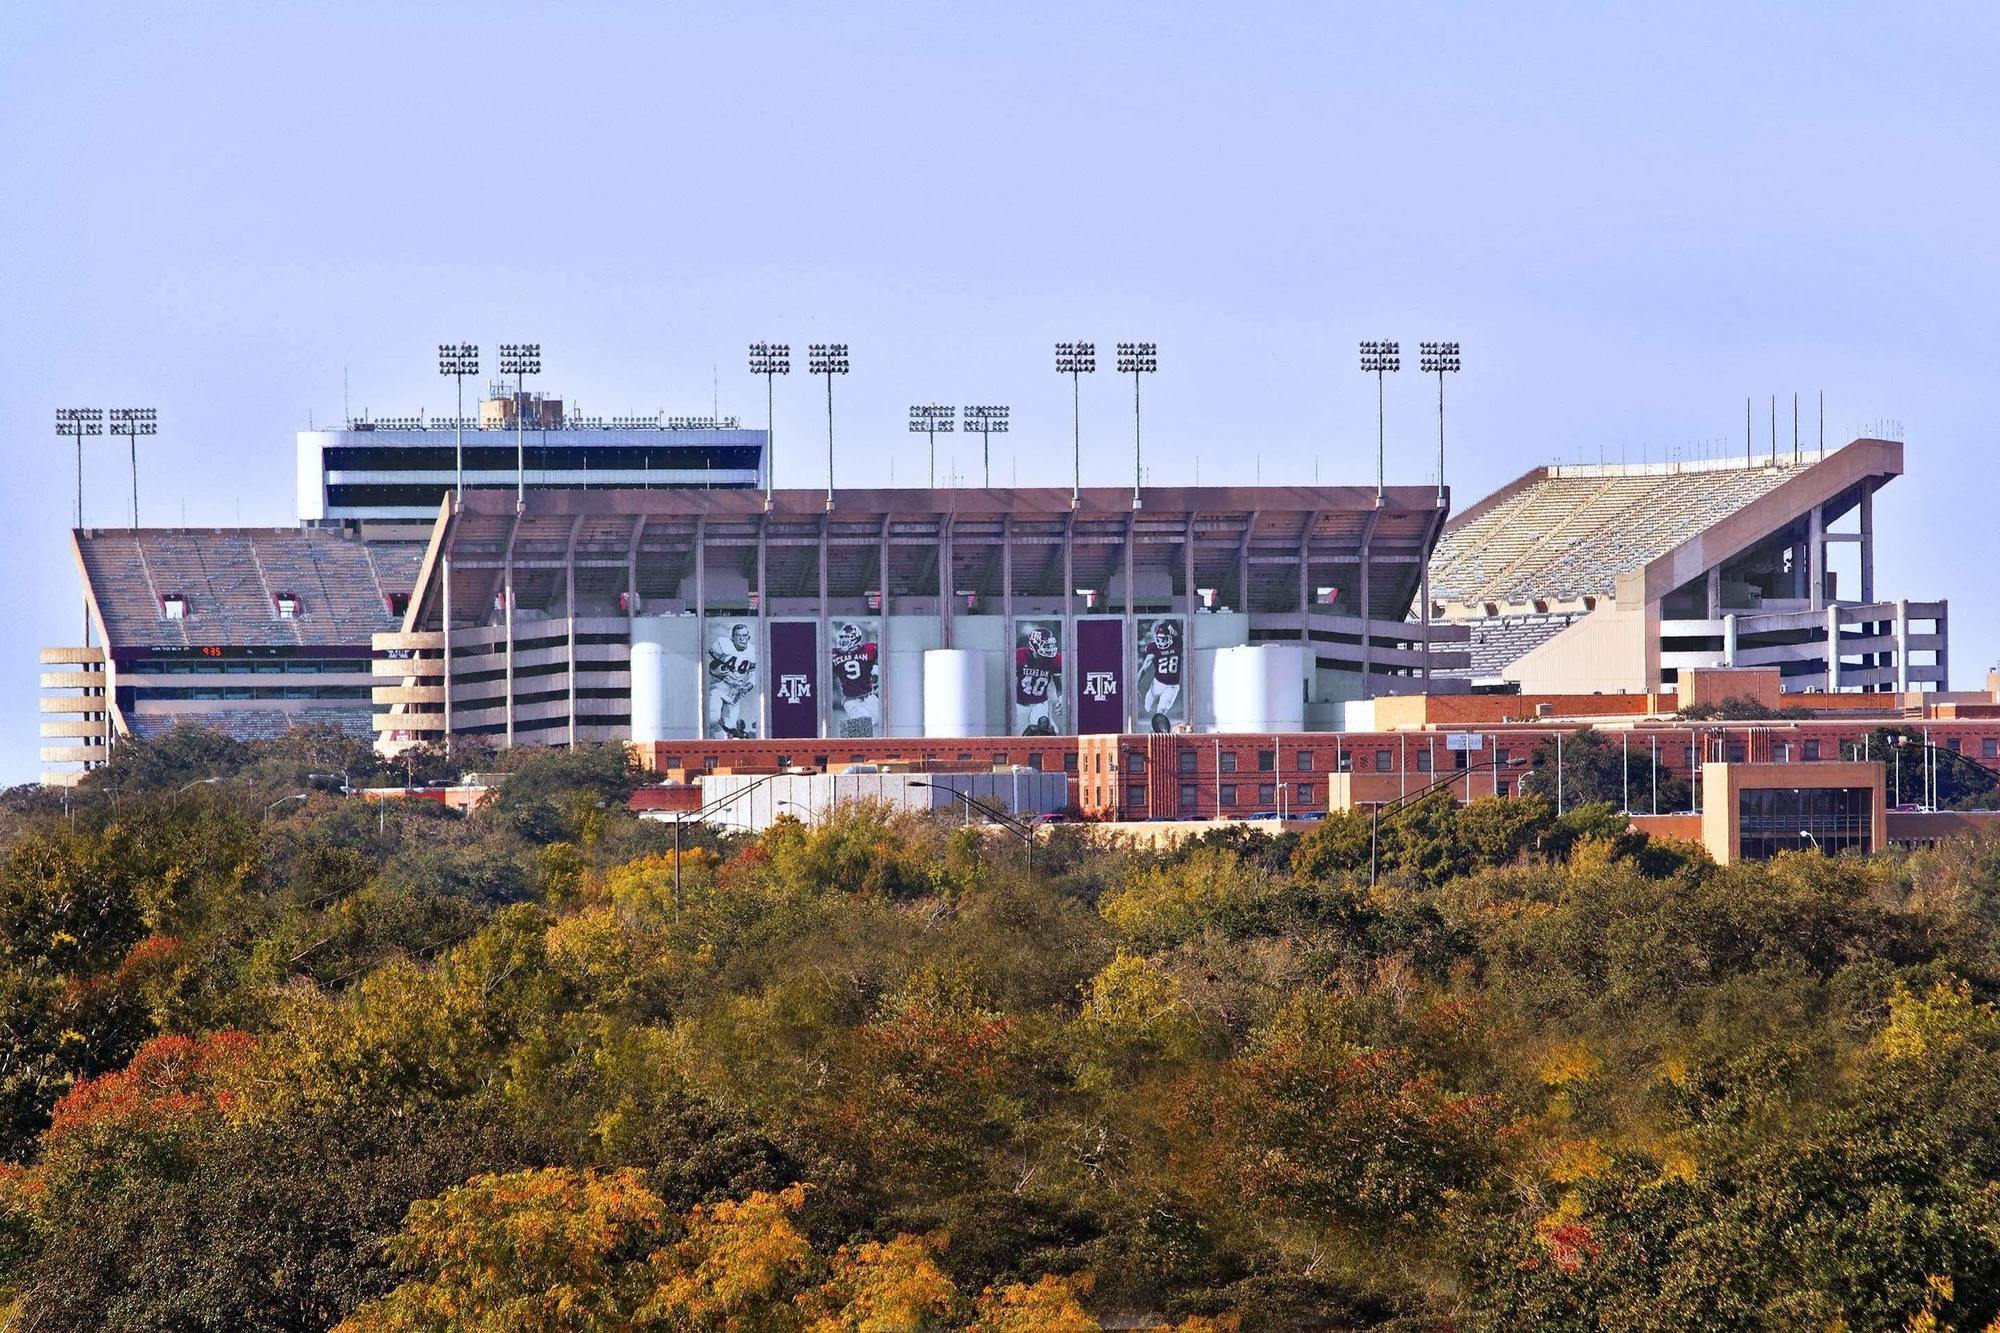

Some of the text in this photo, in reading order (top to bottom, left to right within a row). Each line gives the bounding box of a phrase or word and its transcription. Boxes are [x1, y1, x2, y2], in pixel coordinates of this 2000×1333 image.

[832, 654, 852, 666] TEXAS
[1158, 655, 1179, 674] 28
[844, 660, 861, 680] 9
[1022, 668, 1039, 677] TEXAS
